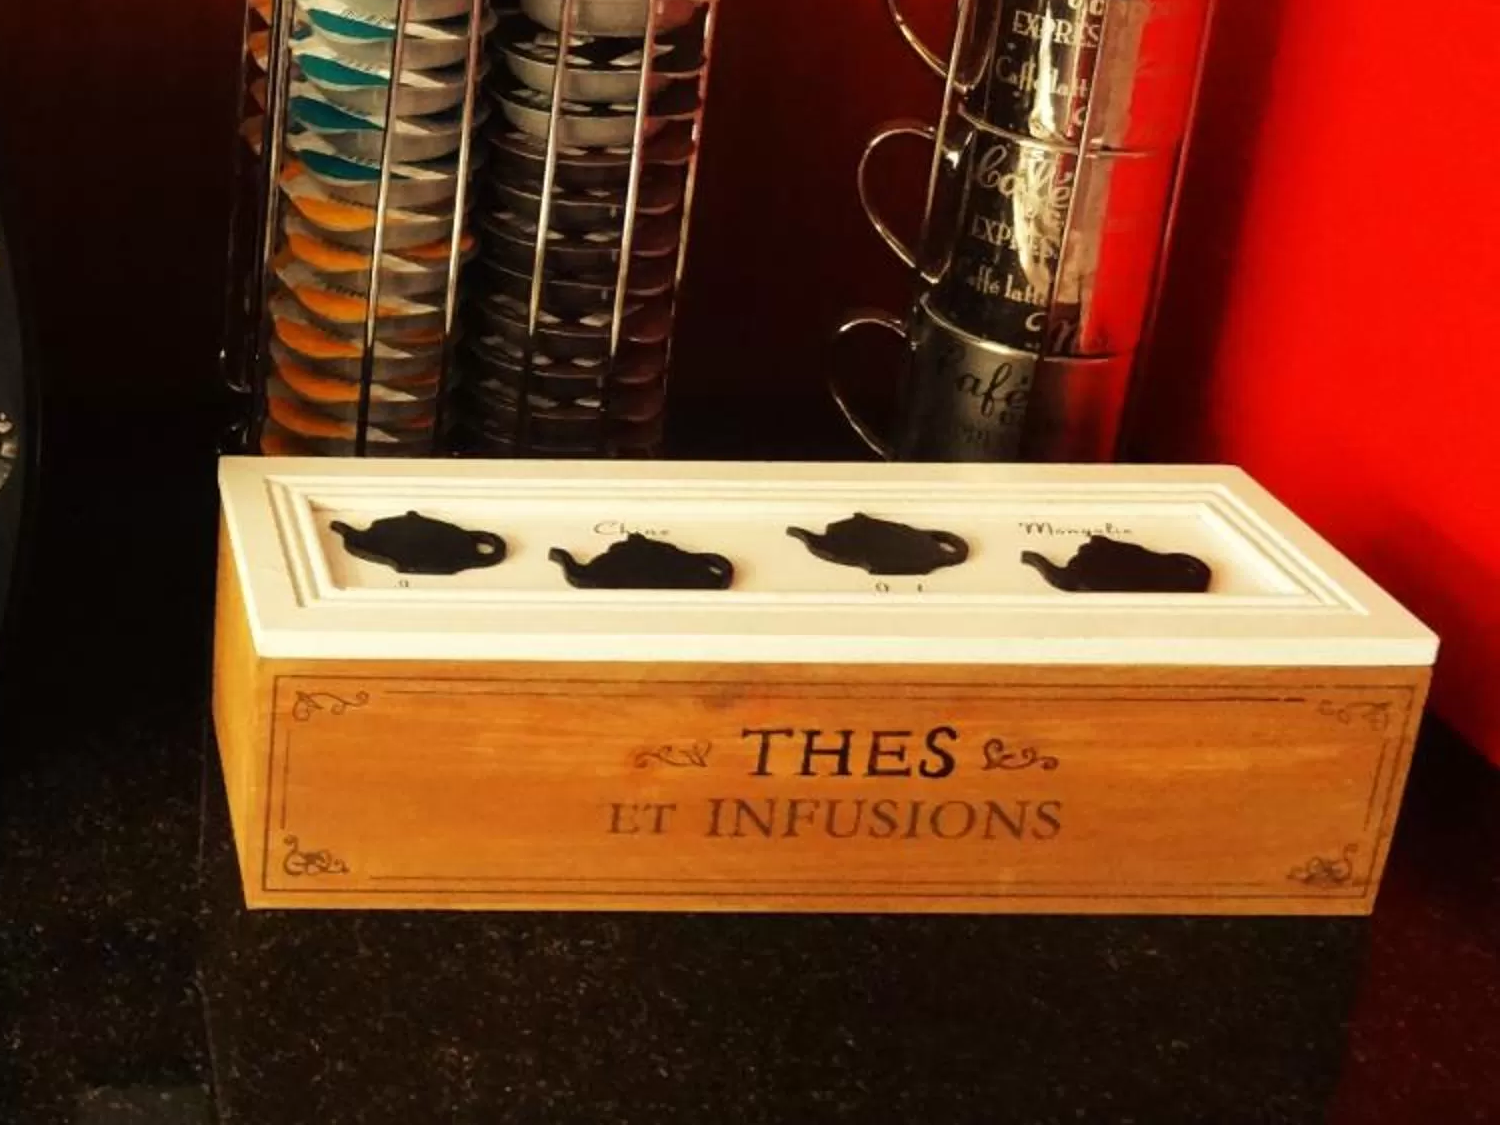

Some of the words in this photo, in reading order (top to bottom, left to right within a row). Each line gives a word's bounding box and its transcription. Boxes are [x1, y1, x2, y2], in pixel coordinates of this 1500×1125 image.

[741, 726, 961, 779] THES
[606, 802, 677, 835] ET
[705, 797, 1063, 841] INFUSIONS
